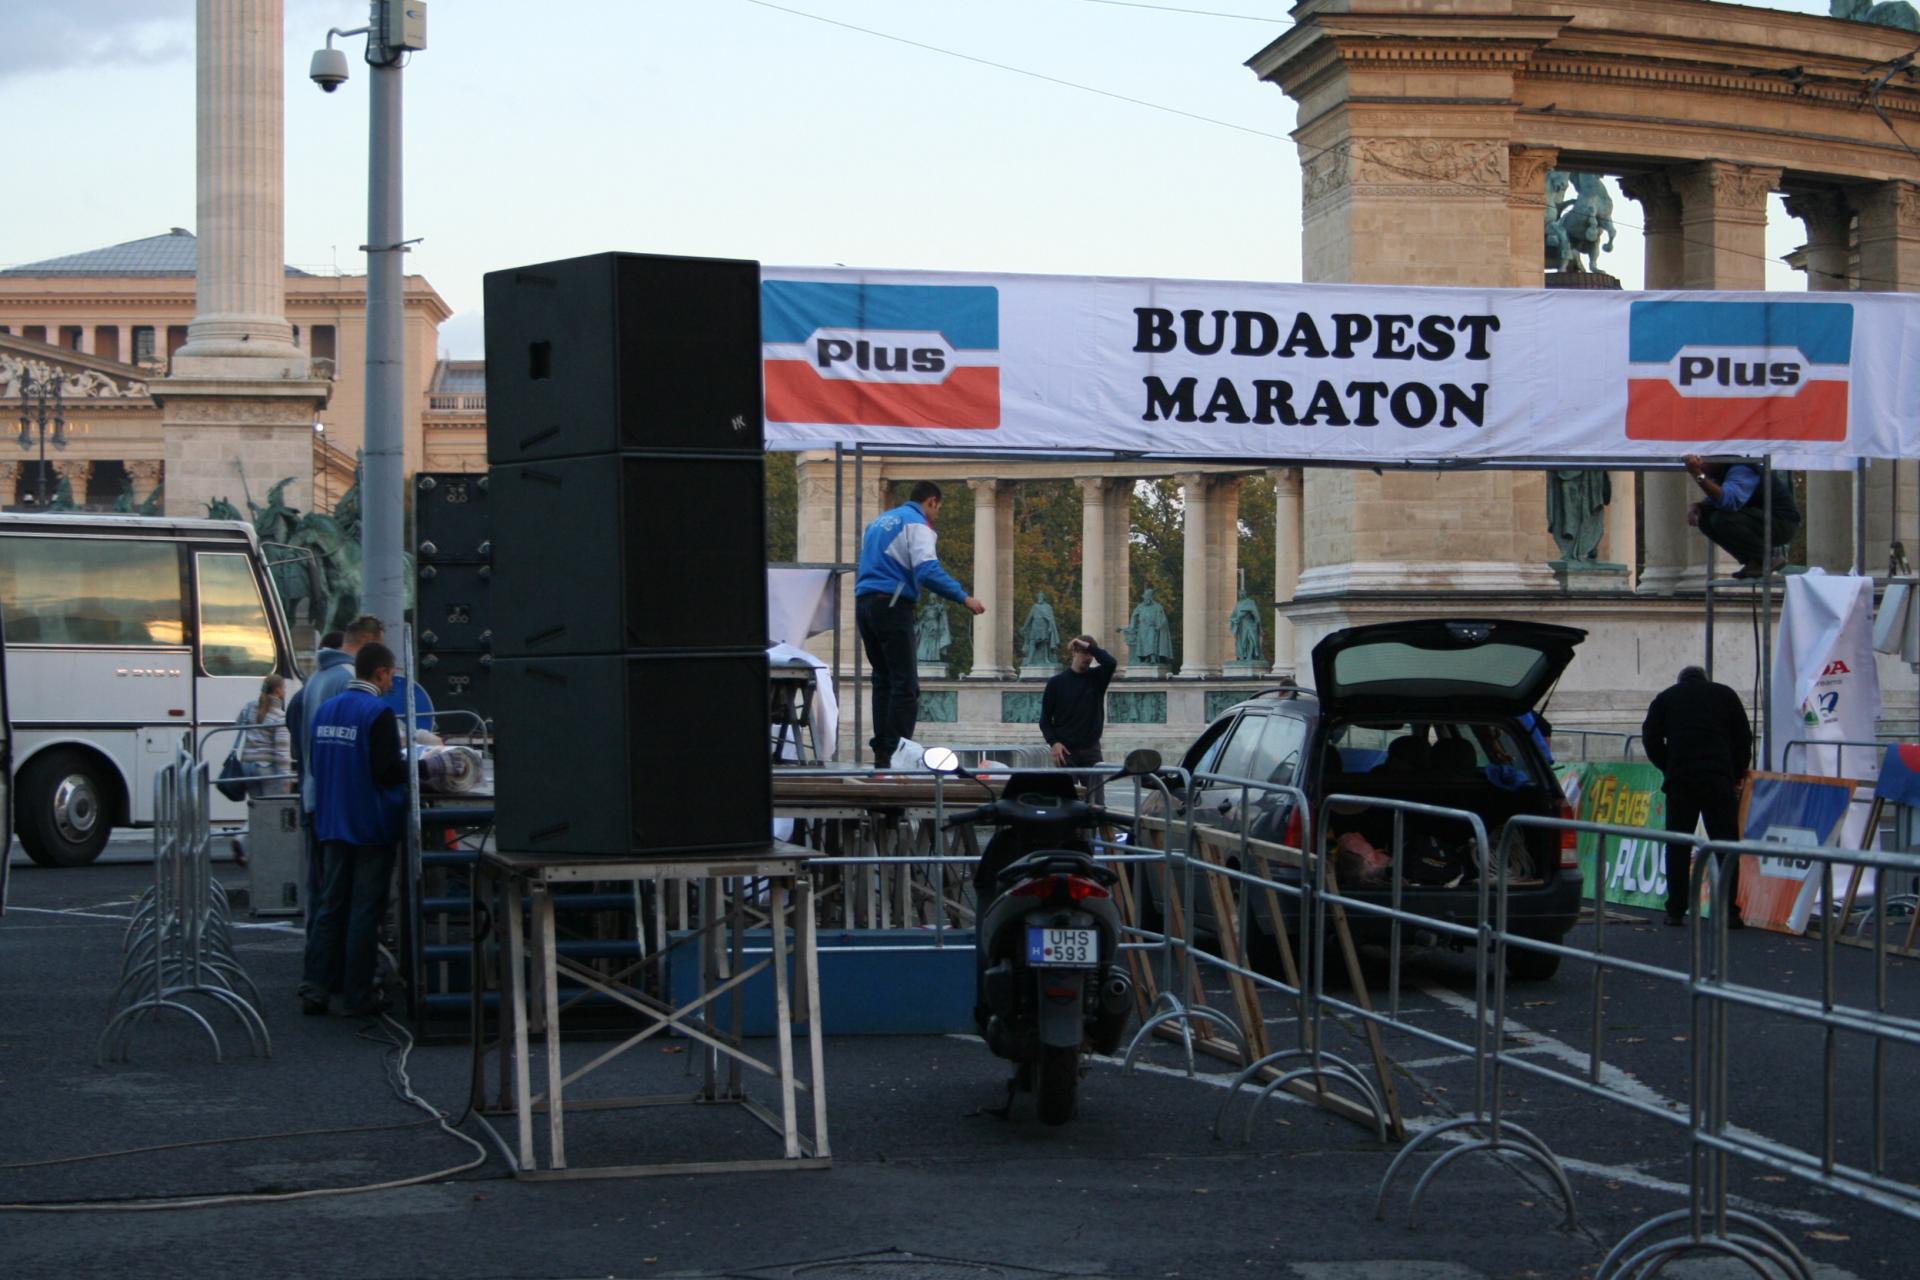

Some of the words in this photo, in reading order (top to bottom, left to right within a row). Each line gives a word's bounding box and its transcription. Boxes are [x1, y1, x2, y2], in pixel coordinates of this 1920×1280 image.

[1133, 307, 1500, 361] BUDAPEST
[817, 338, 945, 373] Plus
[1679, 356, 1800, 388] Plus
[1142, 375, 1490, 428] MARATON
[1032, 946, 1040, 955] H
[1050, 931, 1088, 945] UHS
[1054, 946, 1087, 961] 593
